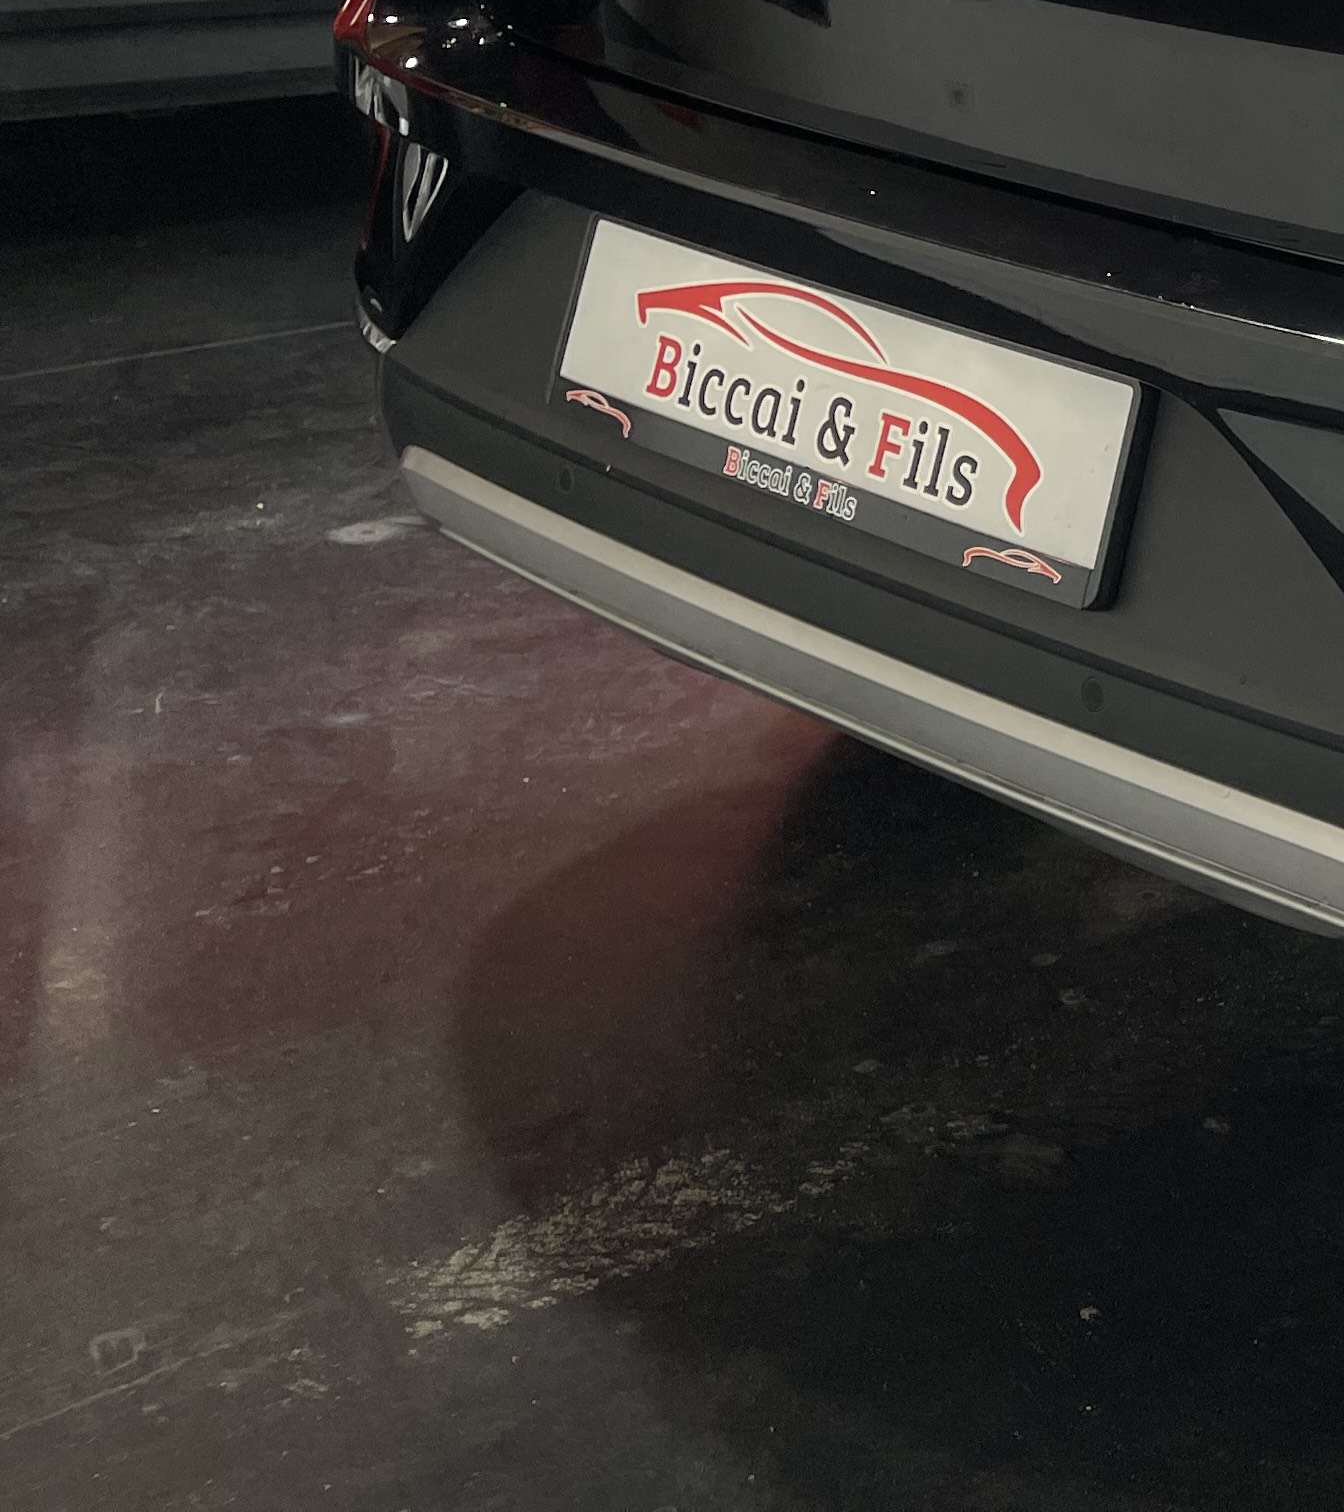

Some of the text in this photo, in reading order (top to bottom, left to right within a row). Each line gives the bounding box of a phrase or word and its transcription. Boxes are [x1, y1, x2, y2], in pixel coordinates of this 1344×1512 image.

[646, 335, 978, 506] Biccai & Fils
[723, 446, 857, 520] Biccai & Fils
